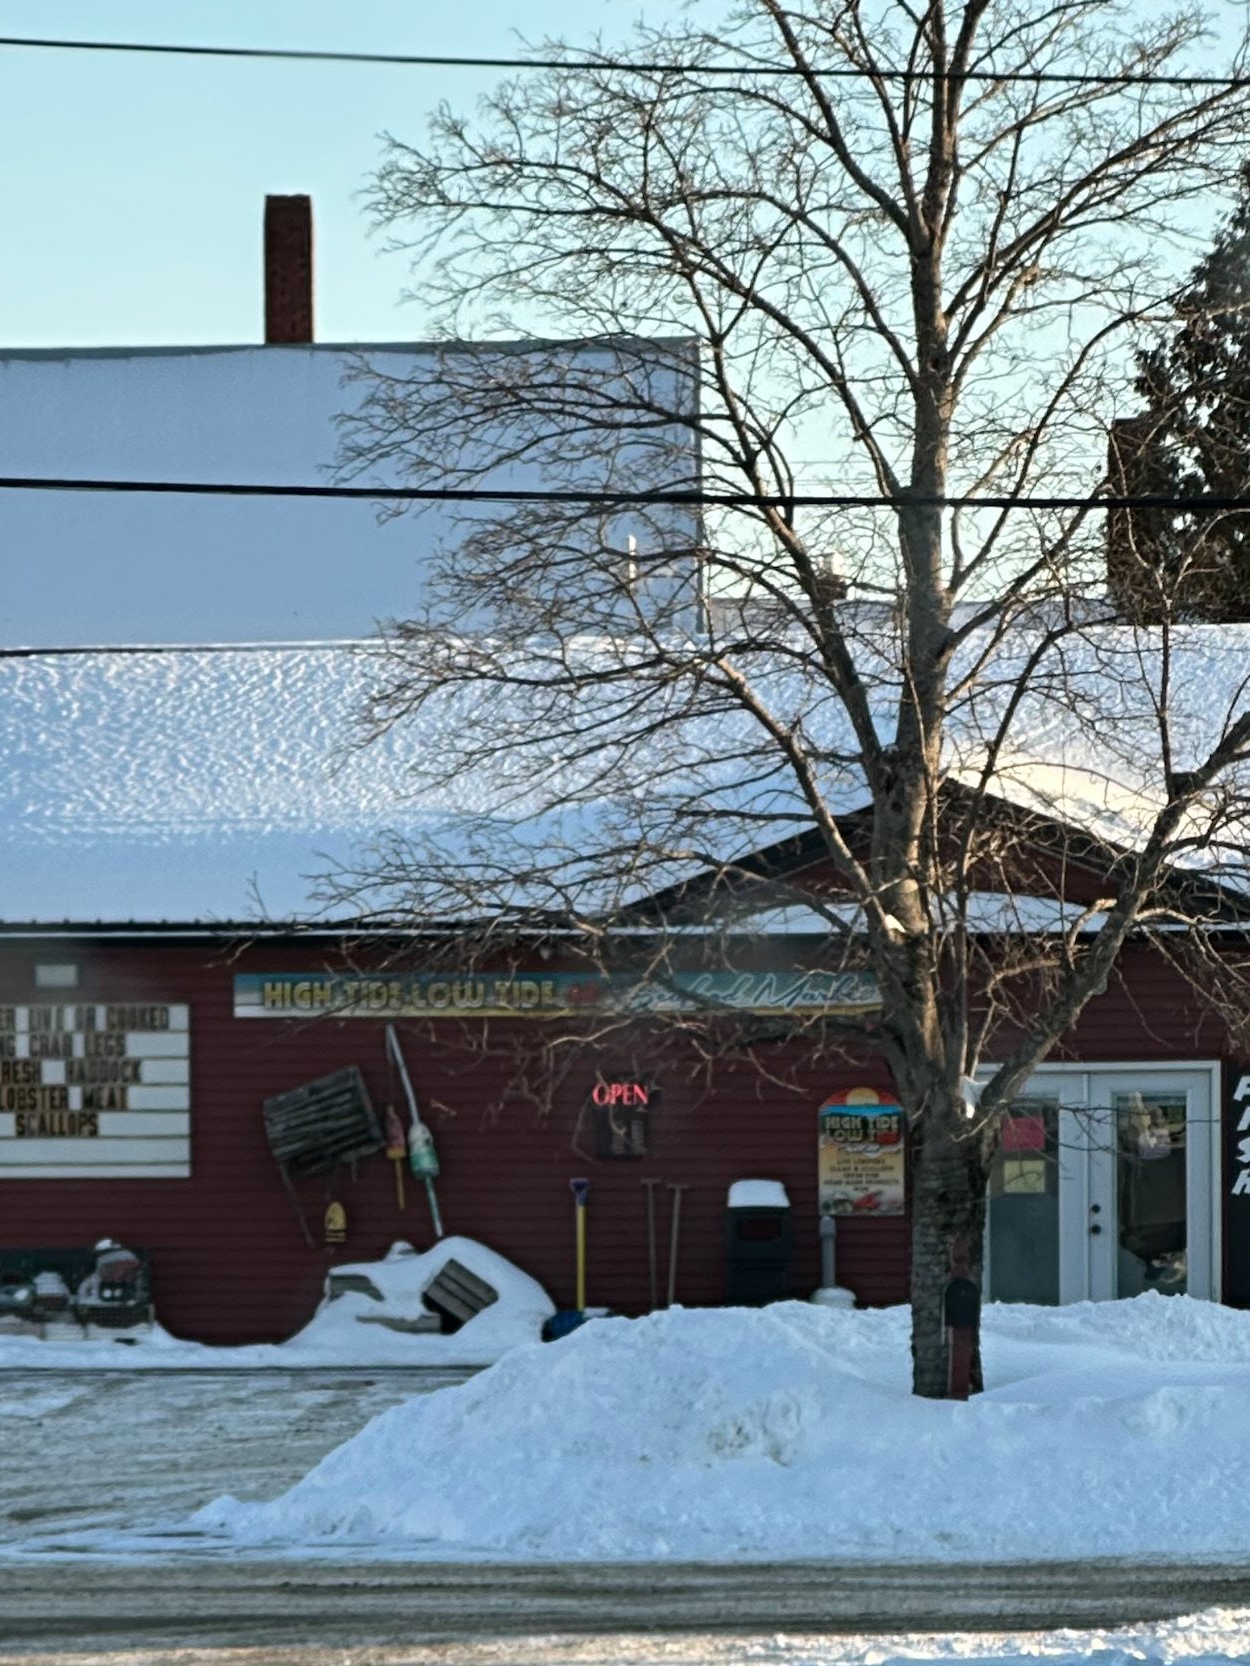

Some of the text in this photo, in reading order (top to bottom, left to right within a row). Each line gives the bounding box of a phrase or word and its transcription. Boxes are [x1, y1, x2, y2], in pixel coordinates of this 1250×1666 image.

[264, 981, 331, 1008] HIGH
[344, 981, 402, 1008] TIDE
[411, 981, 484, 1008] LOW
[494, 980, 554, 1008] TIDE
[29, 1006, 65, 1031] LIVE
[75, 1006, 96, 1031] OR
[106, 1006, 169, 1031] COOKED
[29, 1034, 73, 1057] CRAB
[85, 1034, 126, 1057] LEGS
[66, 1060, 141, 1083] HADDOCK
[82, 1087, 127, 1110] MEAT
[592, 1083, 649, 1105] OPEN
[15, 1113, 98, 1137] SCALLOPS
[825, 1116, 898, 1128] HIGH TIDE
